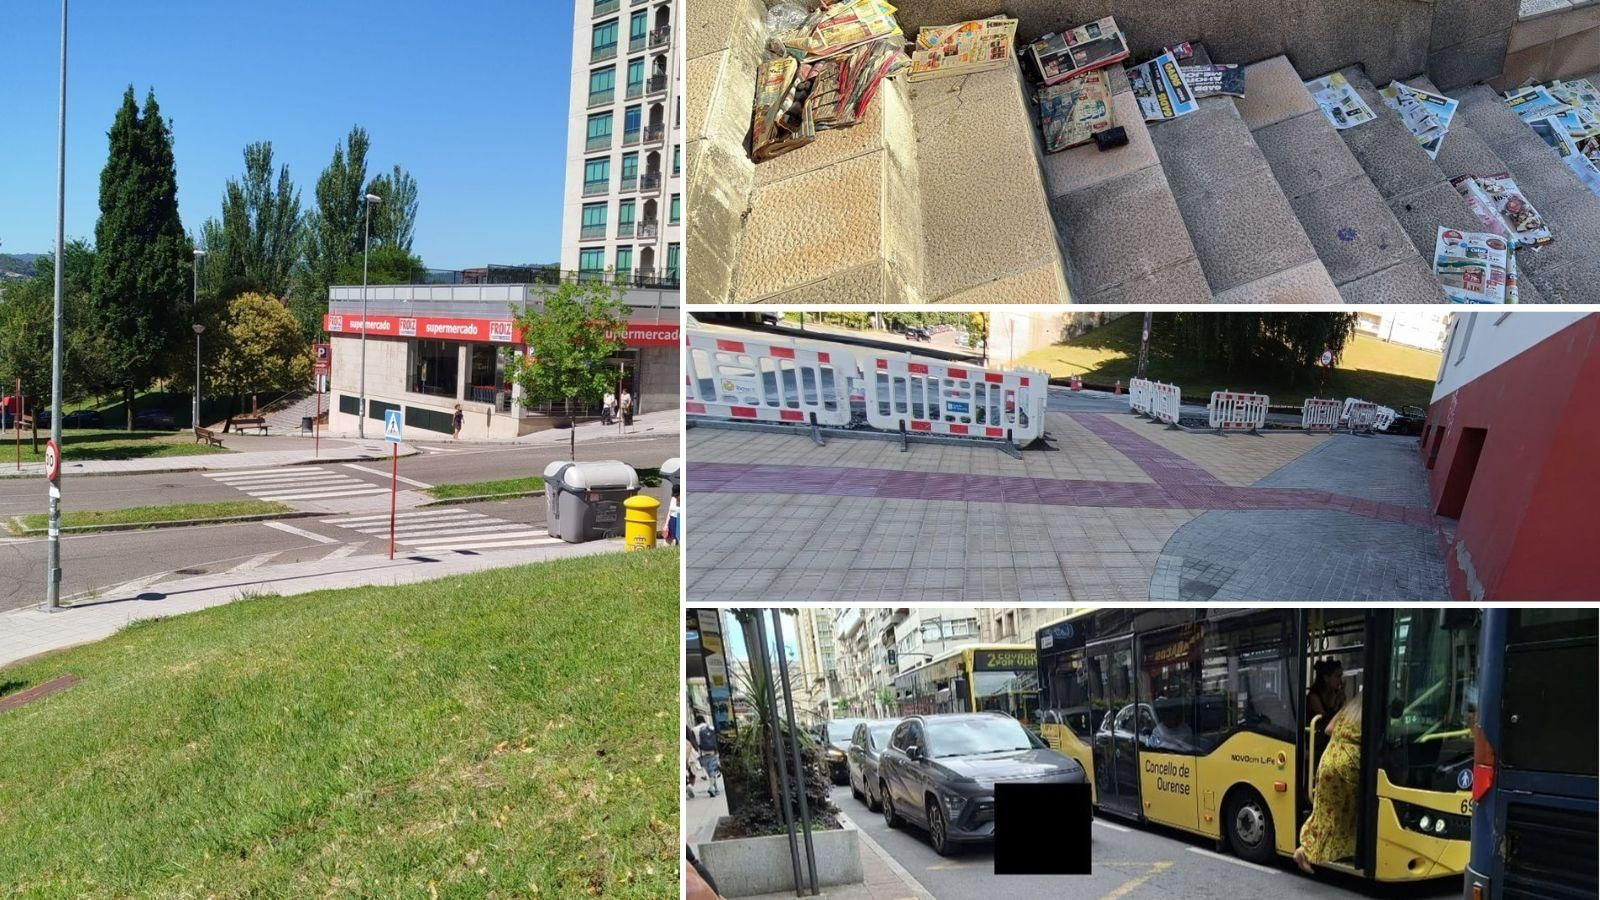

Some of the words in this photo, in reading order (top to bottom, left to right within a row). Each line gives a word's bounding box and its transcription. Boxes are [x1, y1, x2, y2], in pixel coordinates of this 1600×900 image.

[1164, 62, 1182, 88] GADIS
[1157, 92, 1174, 117] GADIS
[399, 318, 416, 330] FROIZ
[426, 323, 478, 336] supermercado
[490, 322, 511, 336] FROIZ
[987, 653, 996, 667] 2
[1145, 759, 1177, 776] Concello
[1178, 763, 1190, 778] de
[1157, 777, 1190, 795] Ourense
